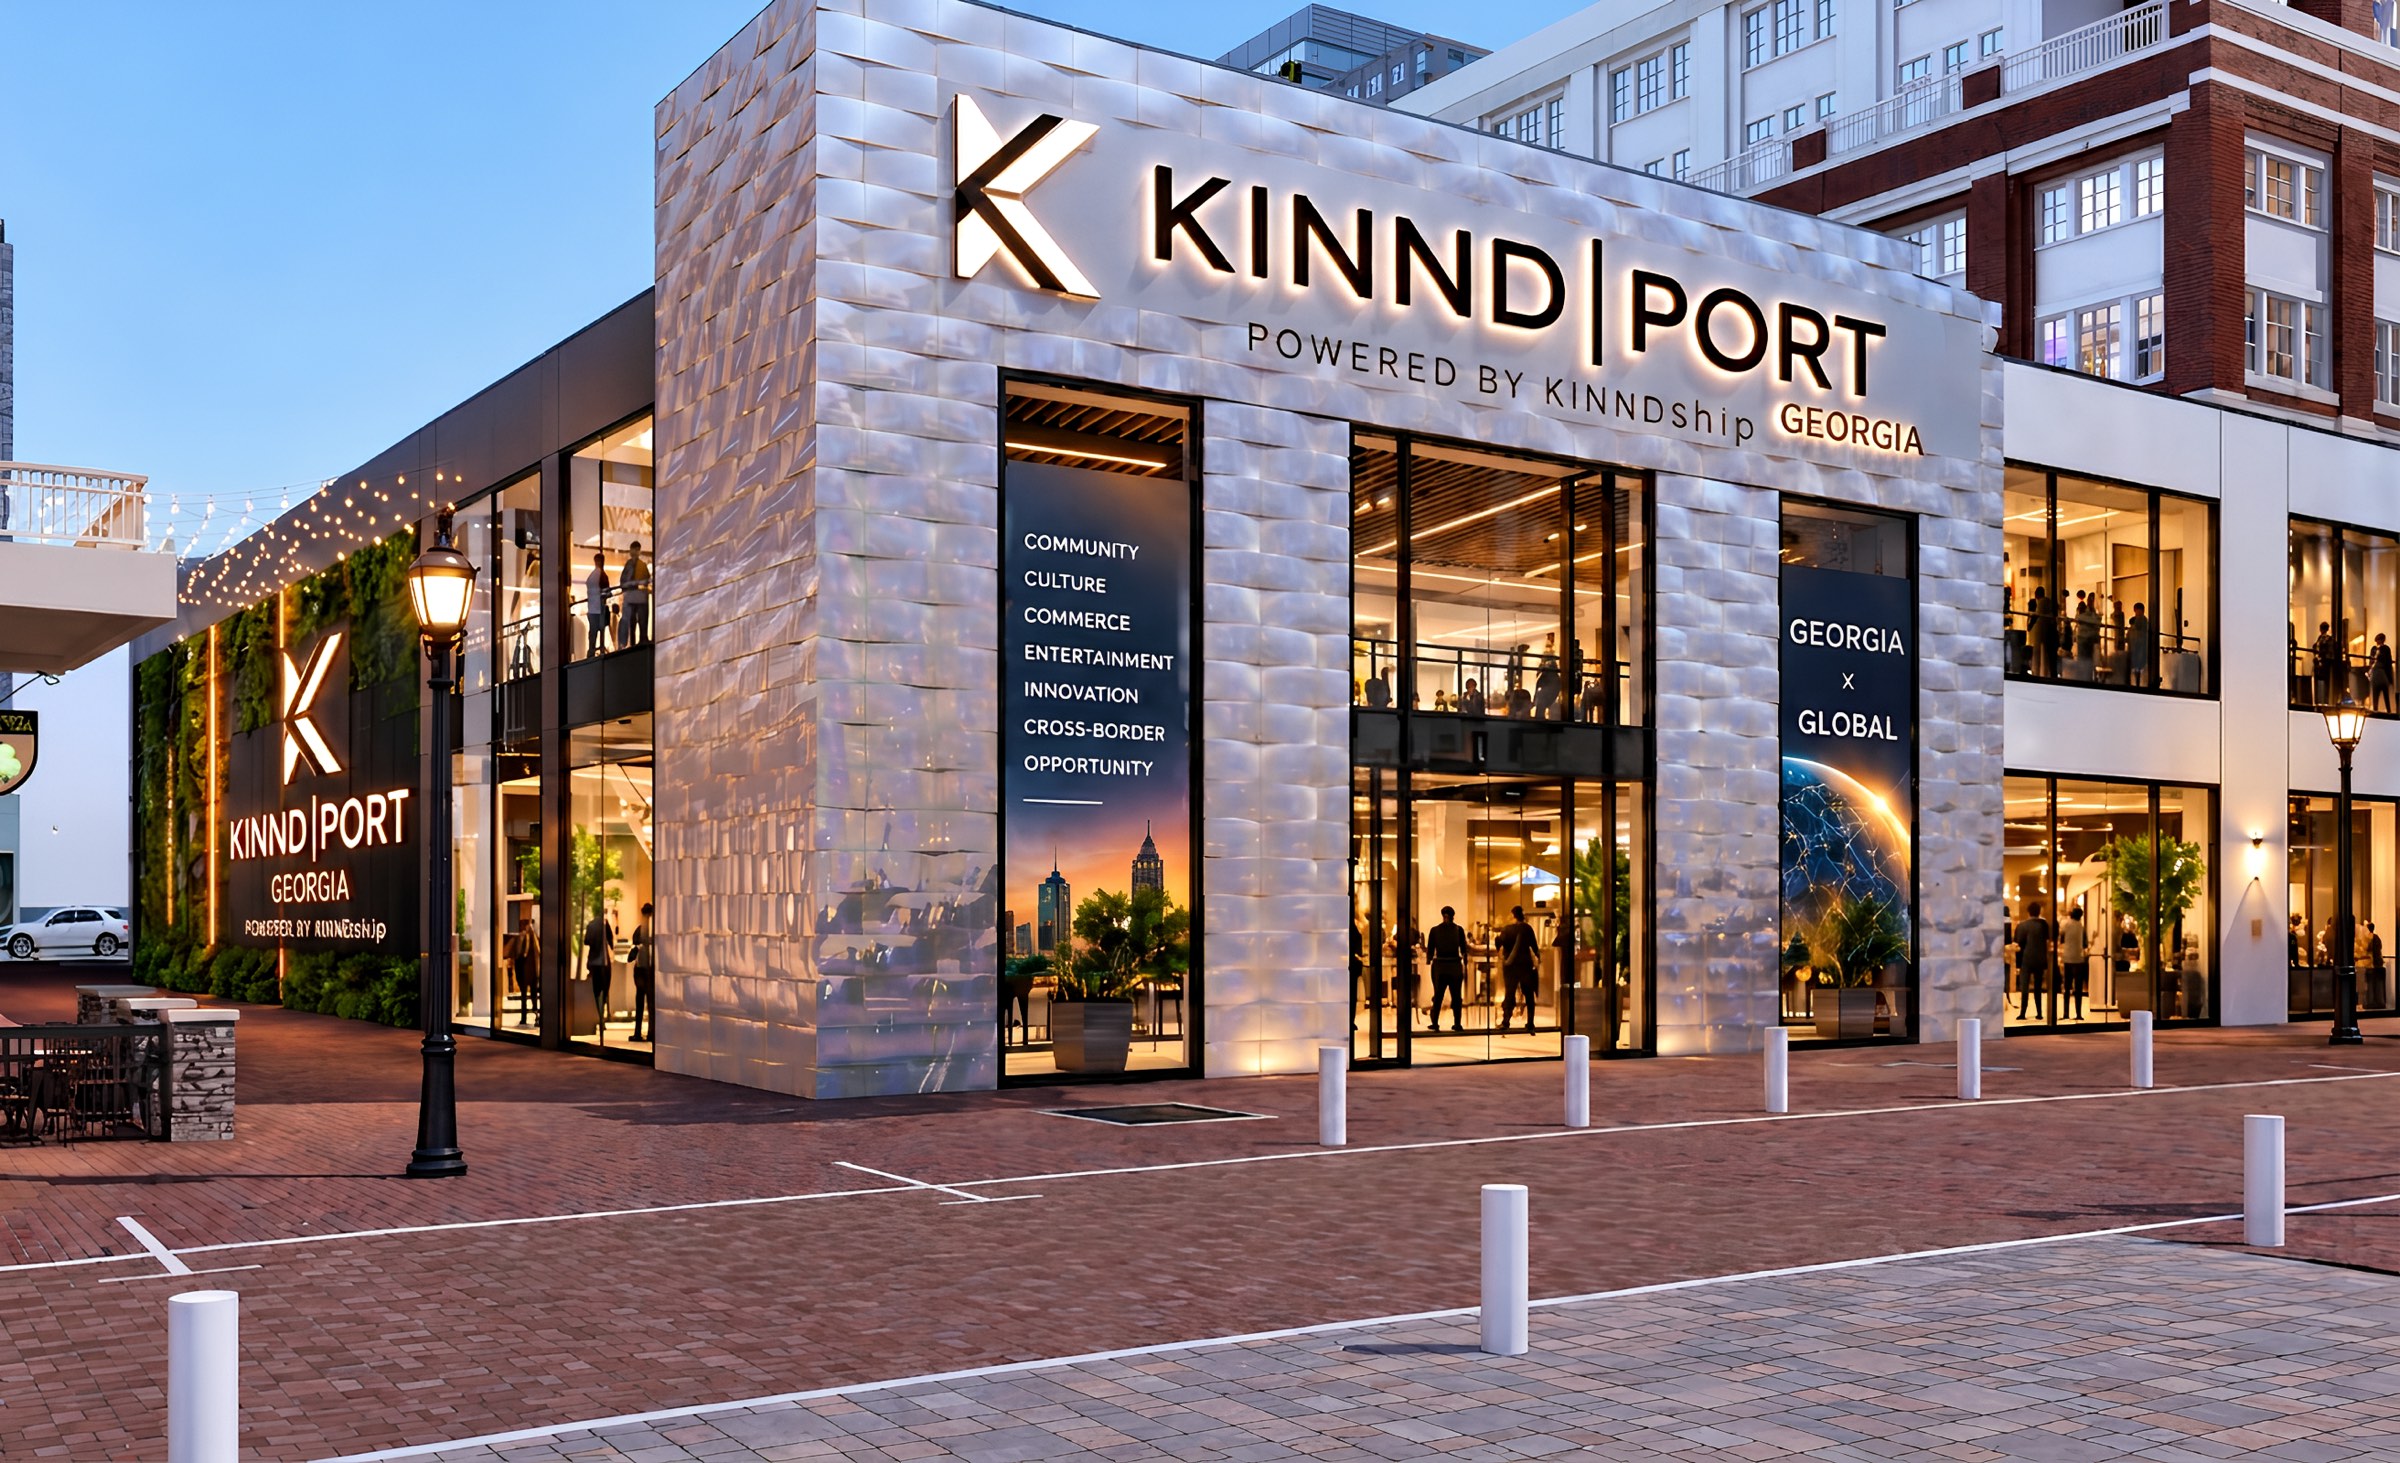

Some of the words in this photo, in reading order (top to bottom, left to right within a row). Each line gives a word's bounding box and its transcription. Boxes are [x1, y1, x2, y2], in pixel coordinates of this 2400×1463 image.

[1248, 322, 1457, 387] POWERED
[1478, 364, 1524, 399] BY
[1545, 376, 1755, 447] KINNDship
[1780, 402, 1926, 456] GEORGIA
[1023, 533, 1140, 561] COMMUNITY
[1023, 570, 1107, 594] CULTURE
[1023, 607, 1131, 631] COMMERCE
[1789, 618, 1905, 656] GEORGIA
[1023, 644, 1175, 671] ENTERTAINMENT
[1023, 681, 1139, 704] INNOVATION
[1023, 718, 1166, 742] CROSS-BORDER
[1798, 709, 1899, 741] GLOBAL
[1023, 755, 1154, 777] OPPORTUNITY
[271, 869, 350, 904] GEORGIA
